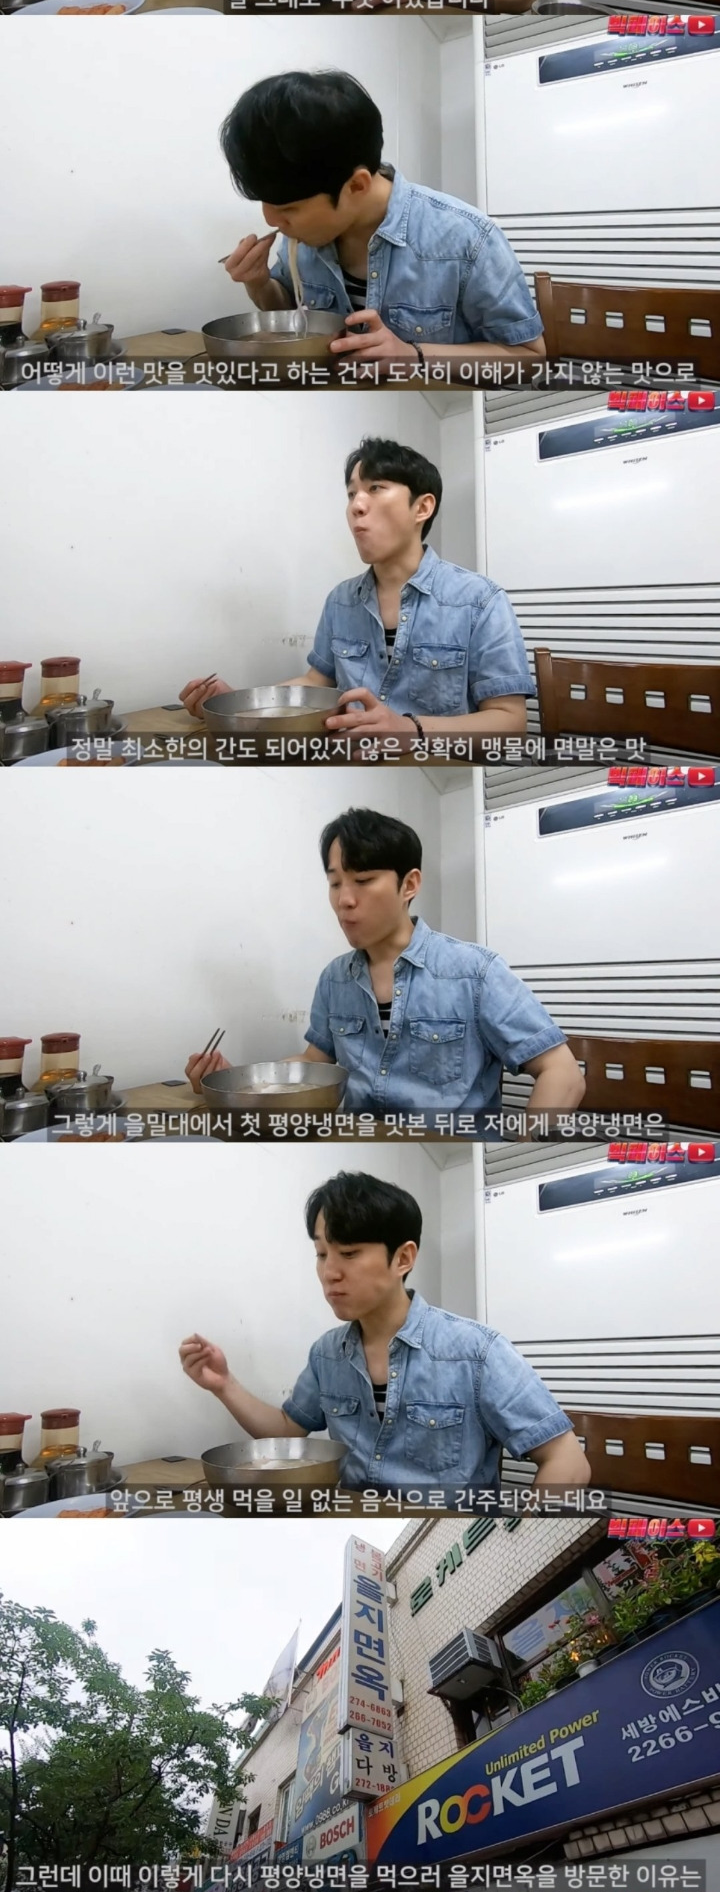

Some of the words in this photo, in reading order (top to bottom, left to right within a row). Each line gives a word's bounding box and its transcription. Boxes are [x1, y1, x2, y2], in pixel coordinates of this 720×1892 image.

[410, 1517, 521, 1617] 로케트
[351, 1574, 389, 1702] 을지면옥
[355, 1733, 394, 1758] 을지
[355, 1755, 398, 1783] 다방
[485, 1735, 545, 1776] Unlimited
[549, 1709, 600, 1744] Power
[417, 1736, 585, 1846] ROCKET
[319, 1815, 355, 1850] BOSCH
